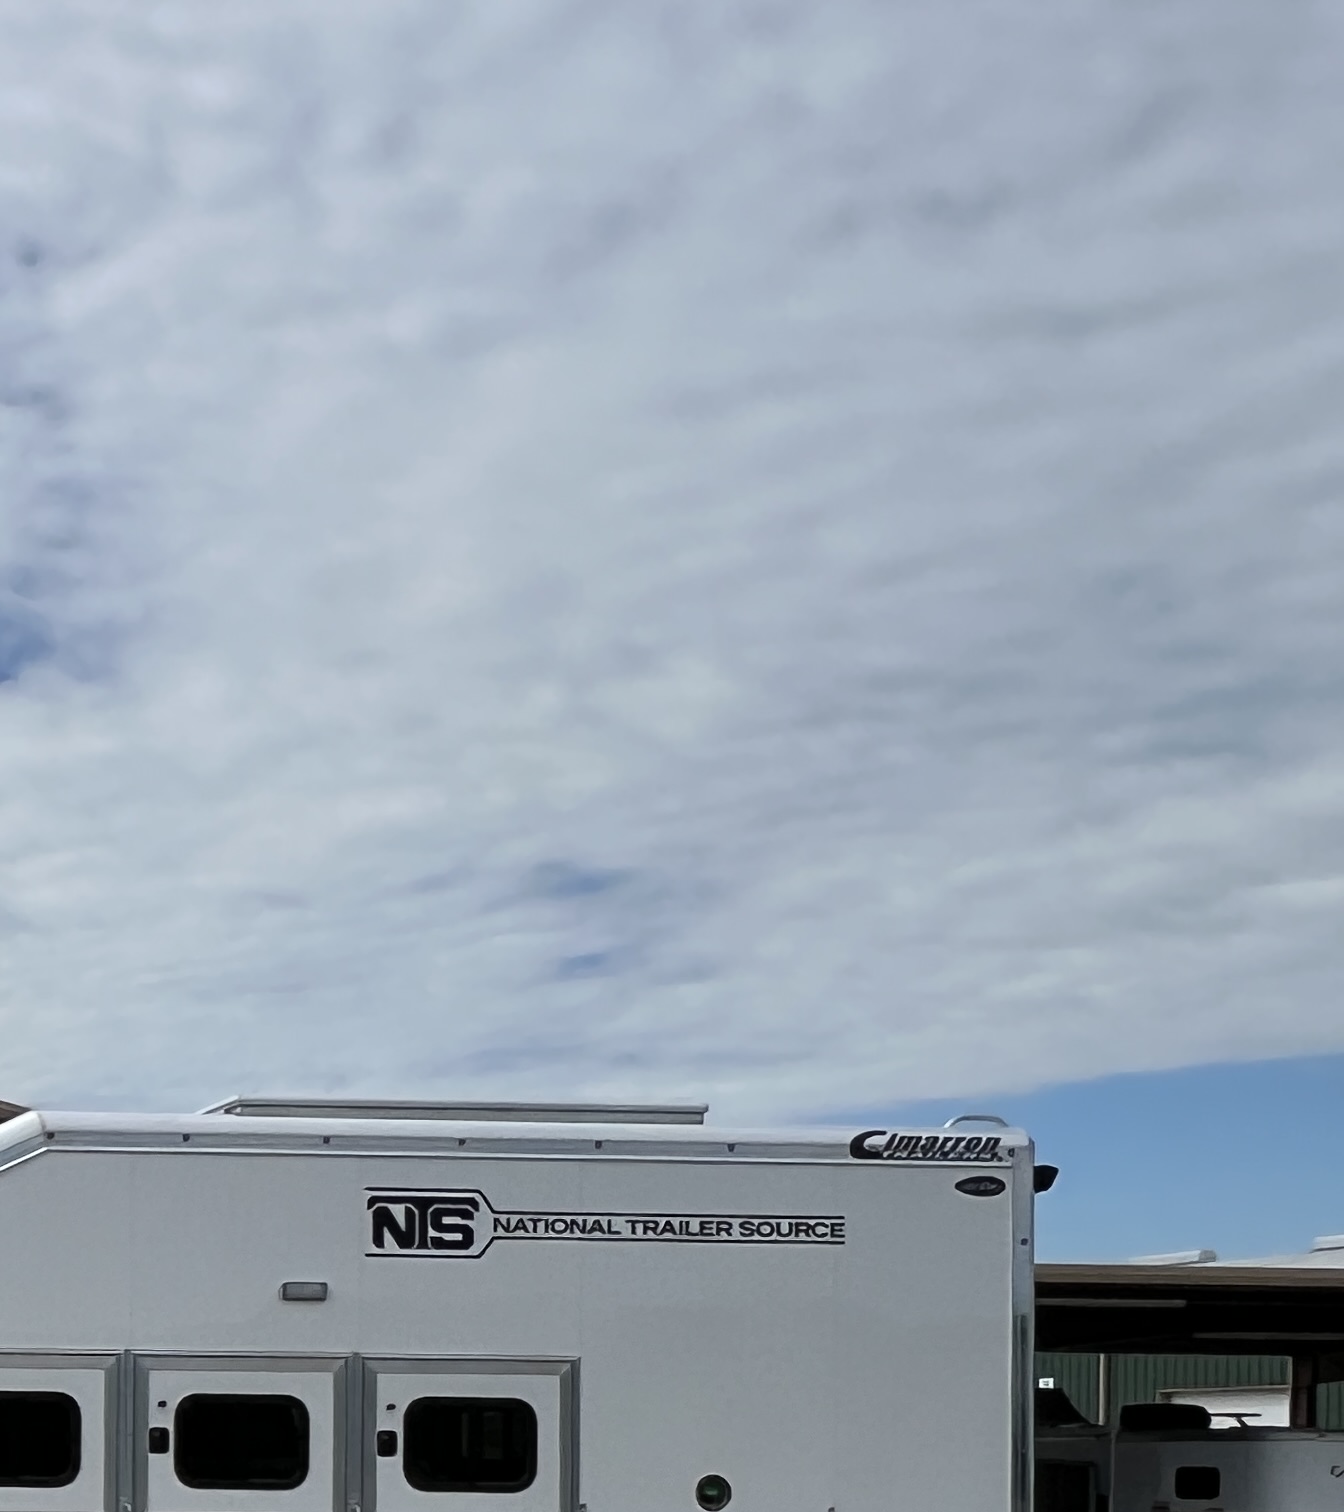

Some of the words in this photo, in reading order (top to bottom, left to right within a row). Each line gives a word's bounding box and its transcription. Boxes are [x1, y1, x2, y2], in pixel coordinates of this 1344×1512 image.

[849, 1130, 1002, 1162] Cimarron
[367, 1195, 480, 1250] NTS
[493, 1217, 622, 1235] NATIONAL
[625, 1219, 733, 1237] TRAILER
[738, 1221, 846, 1239] SOURCE
